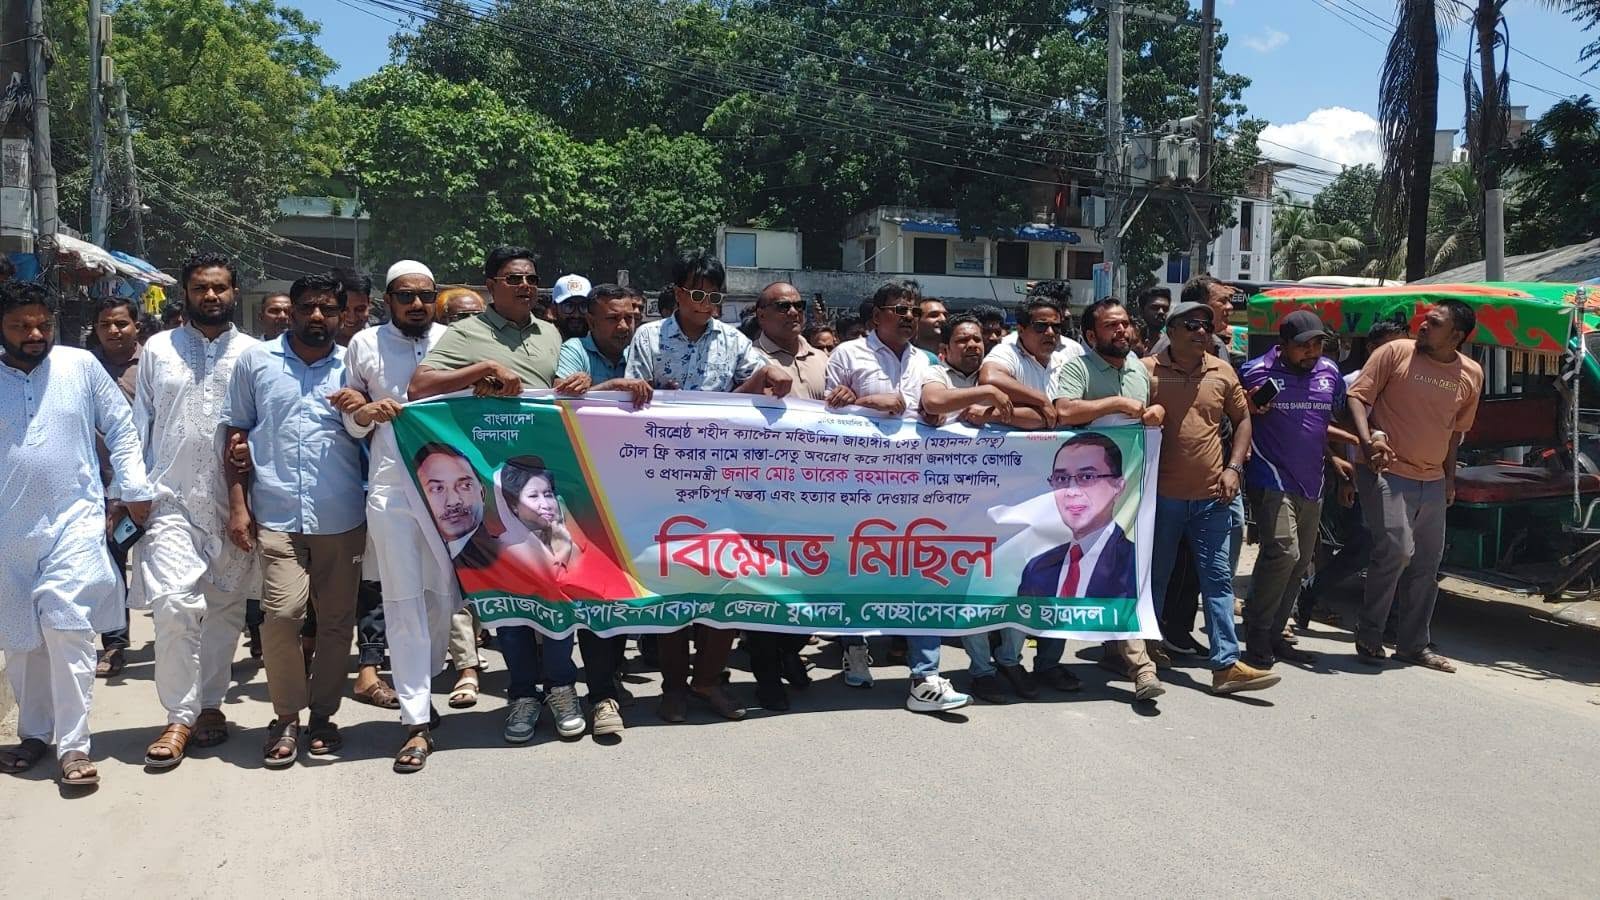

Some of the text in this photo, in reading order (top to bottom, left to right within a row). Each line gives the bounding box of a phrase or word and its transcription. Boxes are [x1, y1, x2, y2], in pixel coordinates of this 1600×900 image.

[483, 413, 535, 426] বাংলাদেশ
[472, 426, 520, 441] জিন্দাবাদ
[645, 422, 694, 440] বীরশ্রেষ্ঠ
[697, 423, 730, 440] শহীদ
[733, 427, 781, 441] ক্যাপ্টেন
[785, 428, 838, 446] মহিউদ্দিন
[843, 430, 891, 449] জাহাঙ্গীর
[619, 444, 1023, 467] টোল ফ্রি করার নামে রাস্তা-সেতু অবরোধ করে সাধারণ জনগণকে ভোগান্তি
[645, 465, 1000, 488] ও প্রধানমন্ত্রী জনাব মোঃ তারেক রহমানকে নিয়ে অশালিন,
[675, 485, 972, 506] কুরুচিপূর্ণ মন্তব্য এবং হত্যার হুমকি দেওয়ার প্রতিবাদে
[654, 514, 999, 587] বিক্ষোভ মিছিল
[724, 600, 780, 619] জেলা
[785, 602, 851, 625] যুবদল,
[860, 600, 1010, 624] স্বেচ্ছাসেবকদল
[1016, 602, 1031, 619] ও
[1039, 603, 1106, 626] ছাত্রদল
